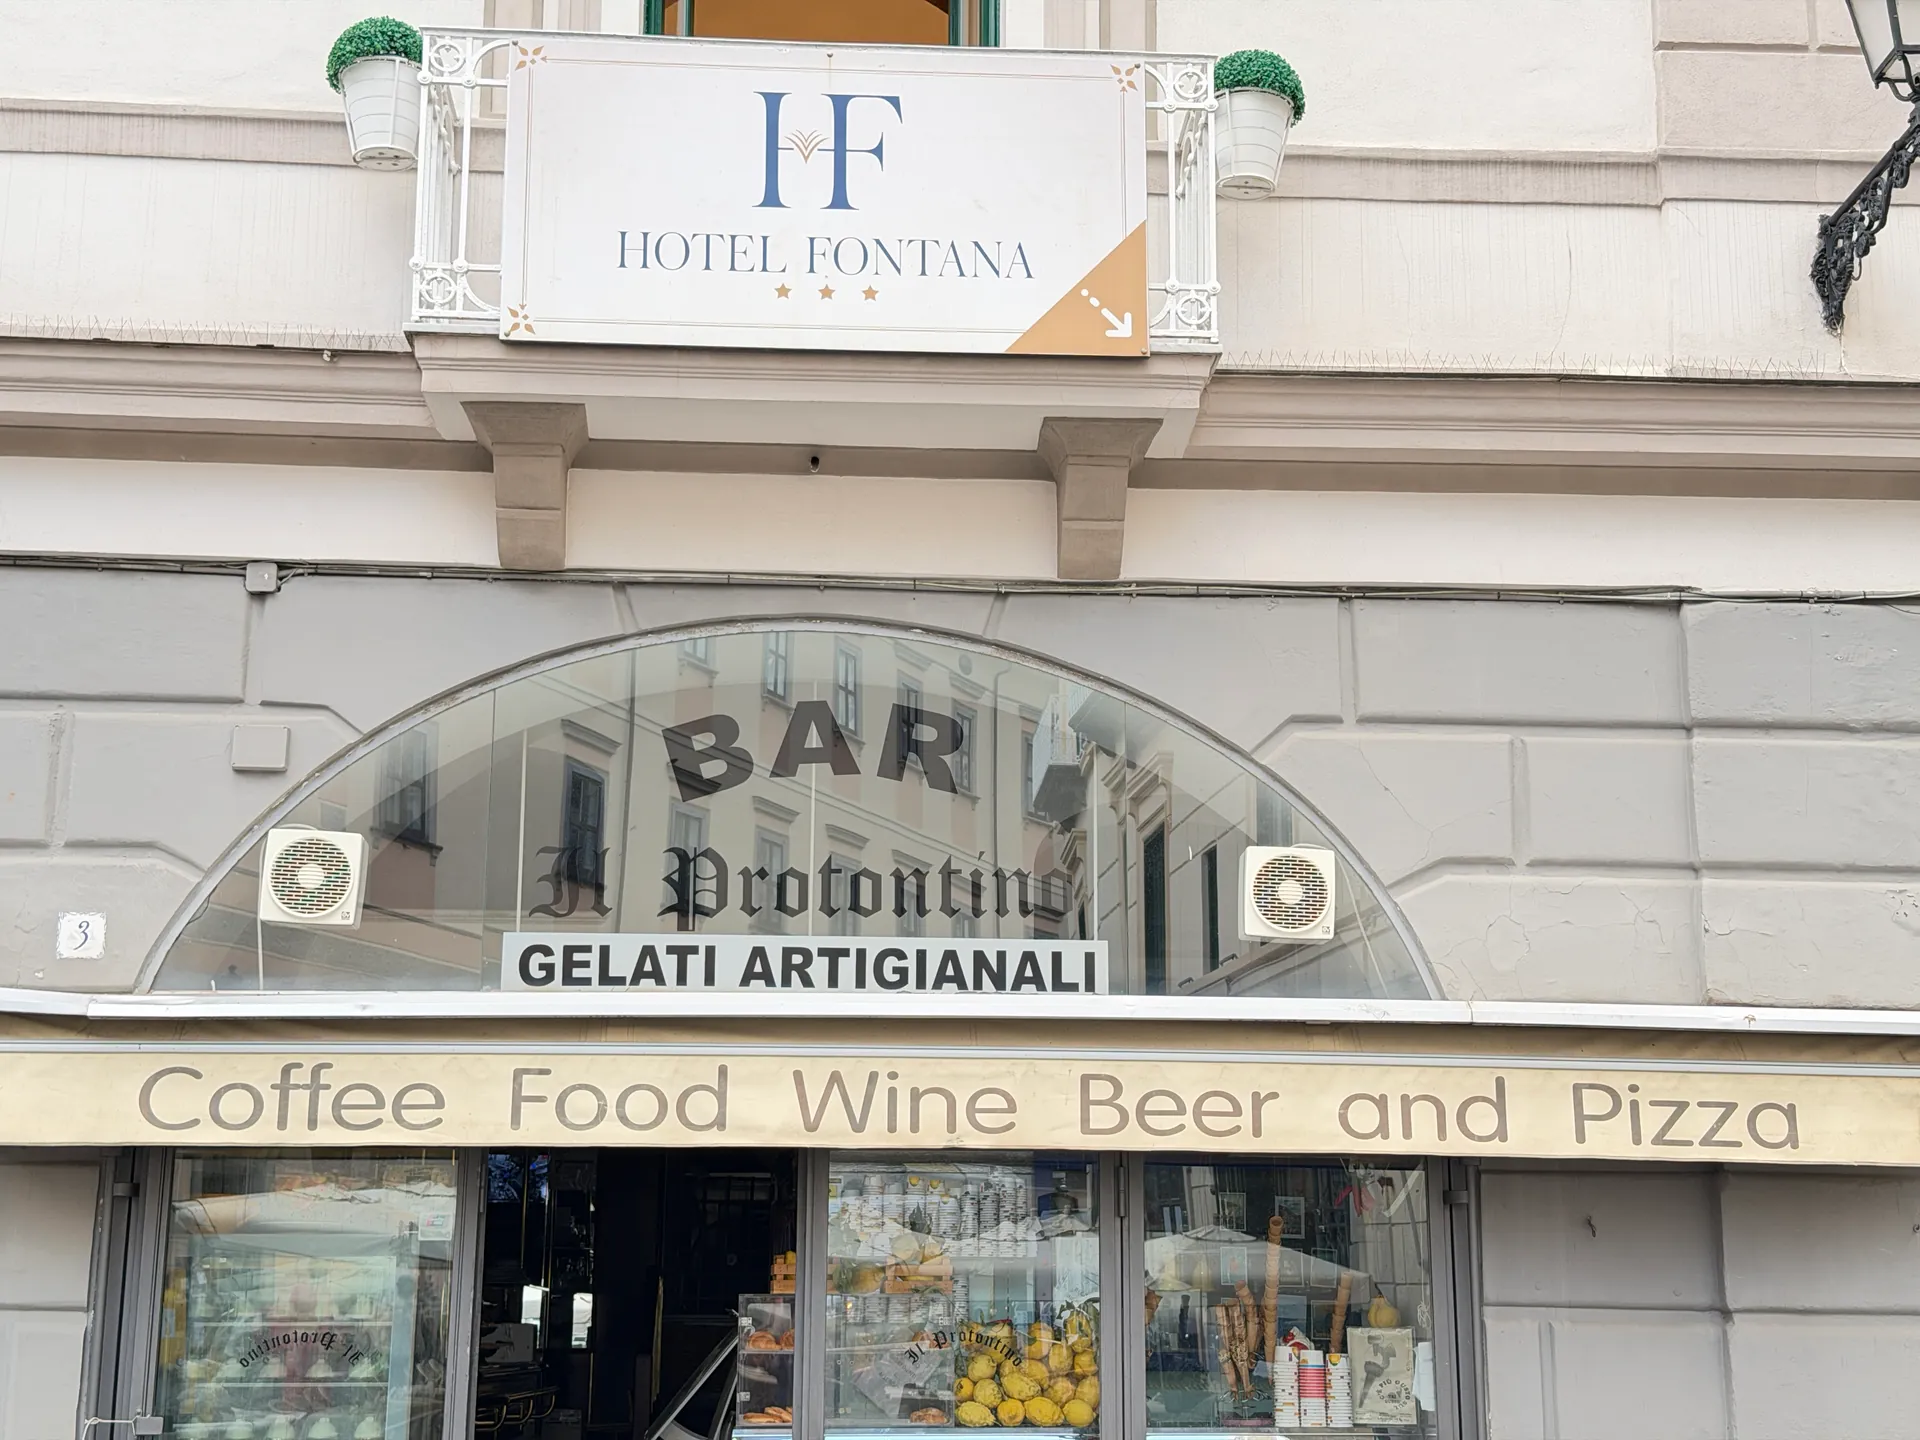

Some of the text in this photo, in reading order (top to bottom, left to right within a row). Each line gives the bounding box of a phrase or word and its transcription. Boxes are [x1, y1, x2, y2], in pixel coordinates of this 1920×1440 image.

[752, 91, 903, 210] HF
[616, 230, 1035, 279] HOTEL FONTANA
[662, 700, 964, 803] BAR
[528, 845, 1074, 932] Il Protontino
[73, 920, 90, 951] 3
[518, 943, 1097, 994] GELATI ARTIGIANALI
[138, 1061, 1799, 1150] Coffee Food Wine Beer and Pizza
[904, 1343, 925, 1365] Il
[932, 1330, 1022, 1367] Protontino
